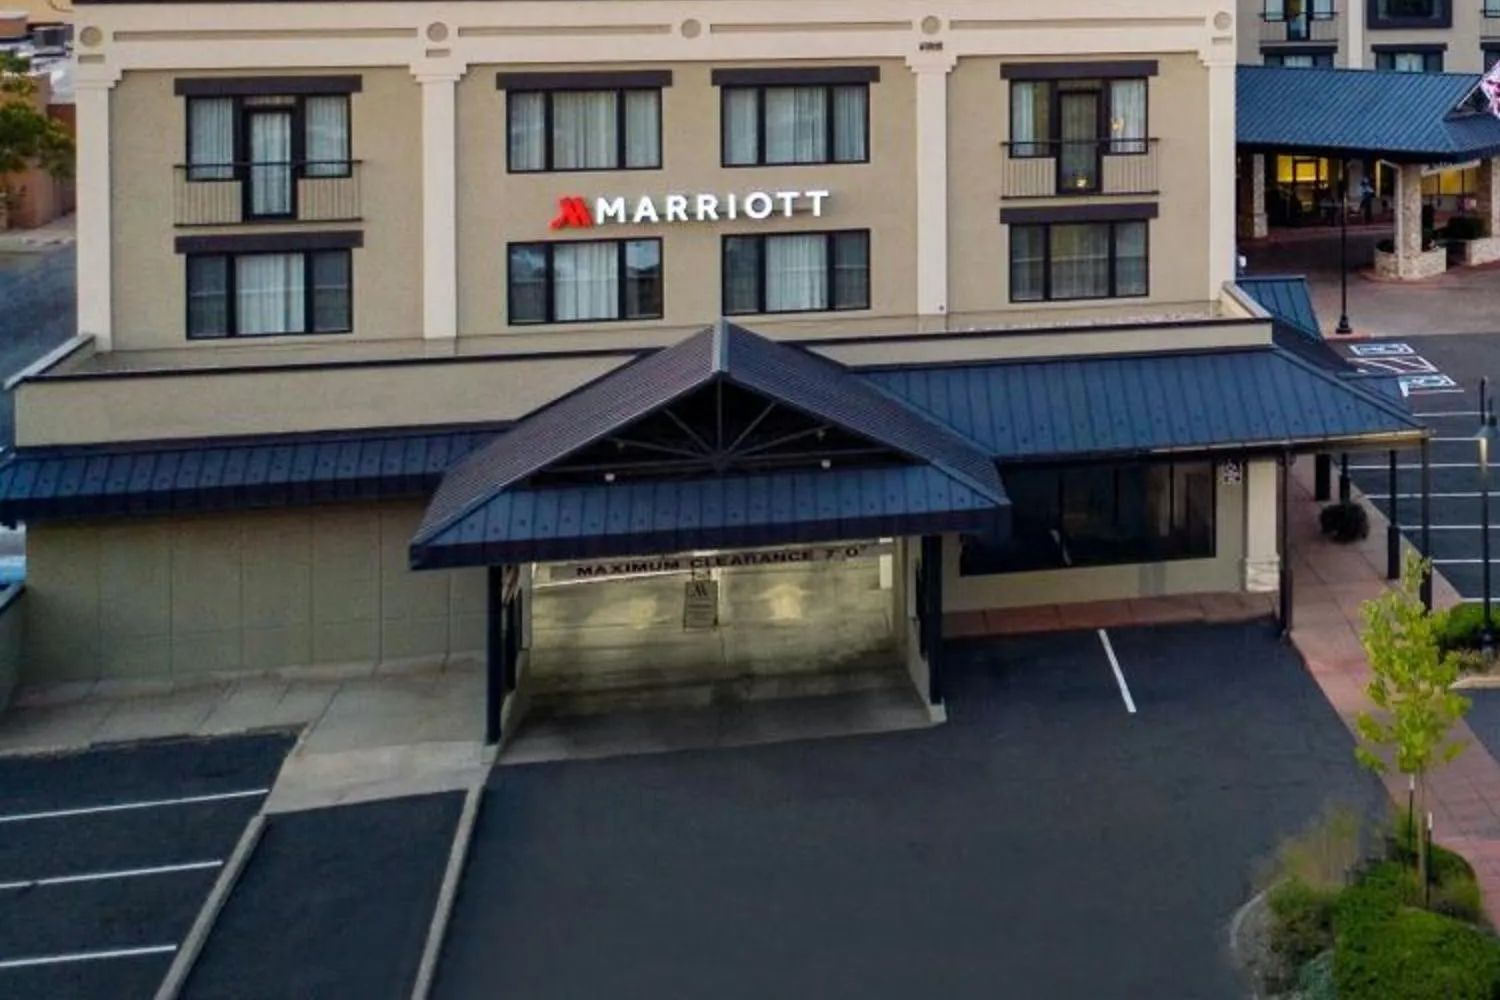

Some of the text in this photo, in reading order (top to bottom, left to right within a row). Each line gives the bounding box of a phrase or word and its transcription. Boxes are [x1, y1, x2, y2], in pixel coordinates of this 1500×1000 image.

[596, 190, 829, 225] MARRIOTT
[576, 561, 679, 577] MAXIMUM
[690, 549, 813, 569] CLEARANCE
